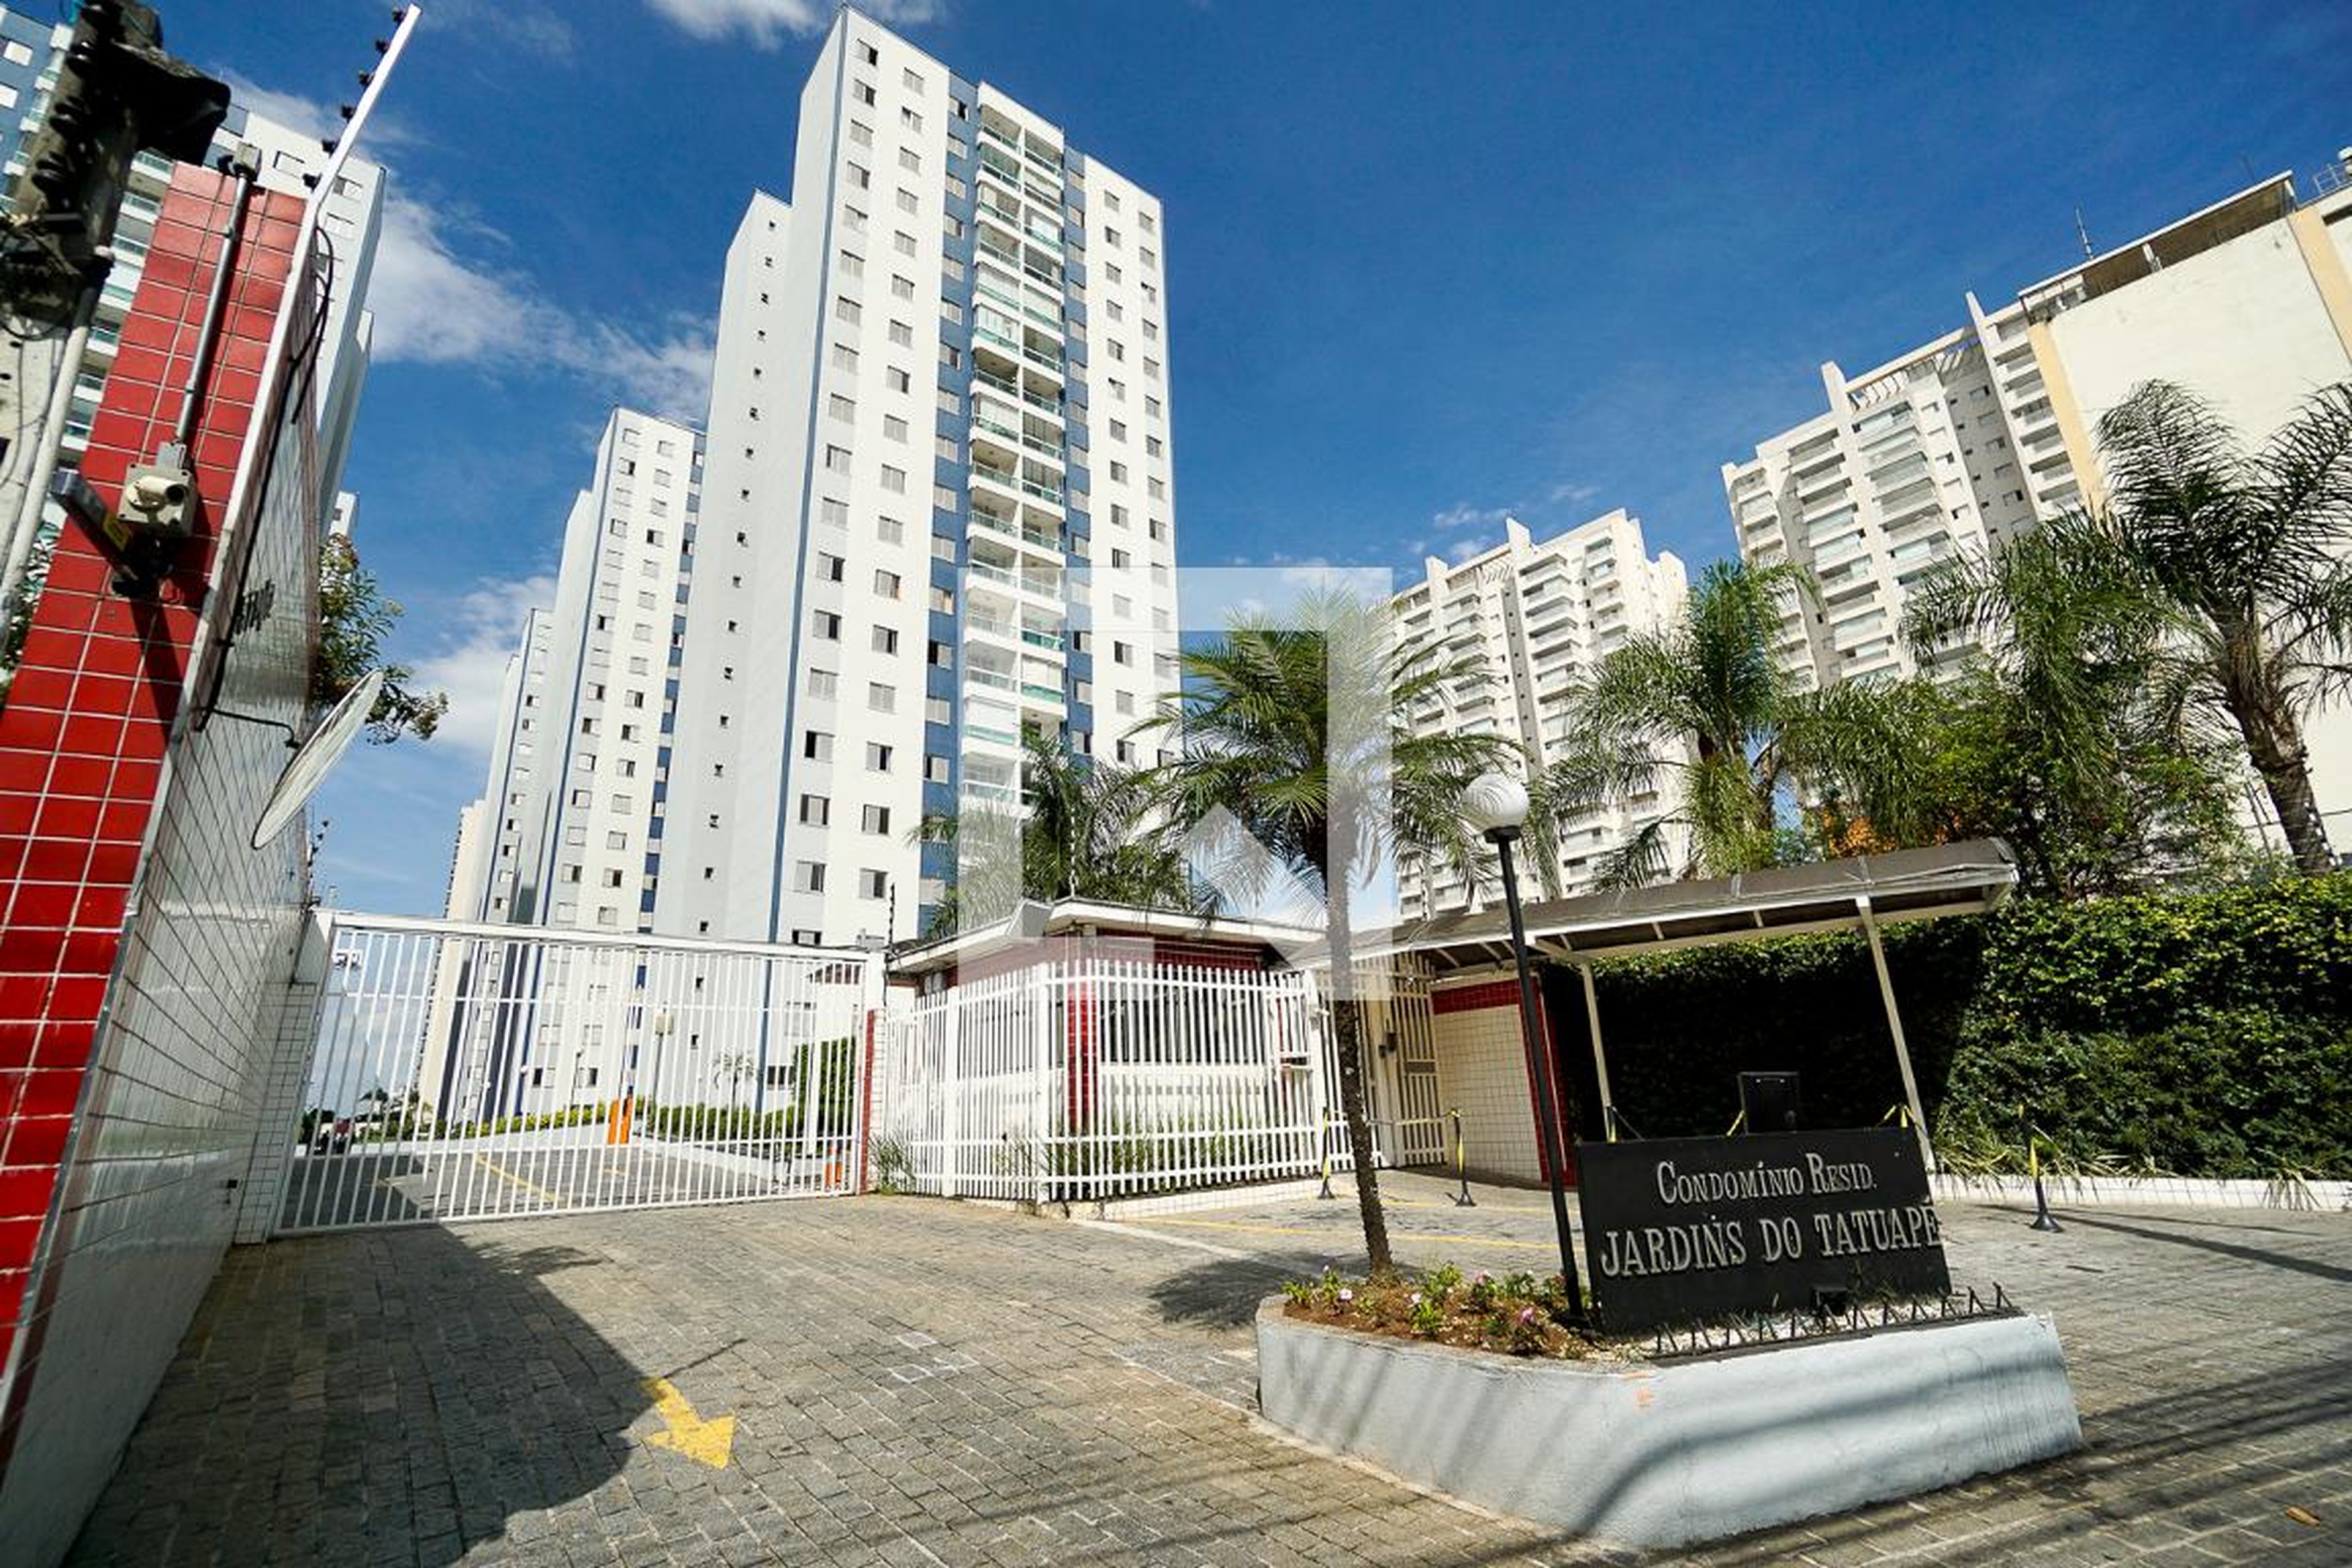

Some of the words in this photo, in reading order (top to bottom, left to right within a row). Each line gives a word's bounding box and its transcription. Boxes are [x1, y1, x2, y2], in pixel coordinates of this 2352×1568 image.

[1806, 1153, 1878, 1194] RESID.
[1600, 1220, 1747, 1277] JARDINS
[1759, 1216, 1803, 1262] DO
